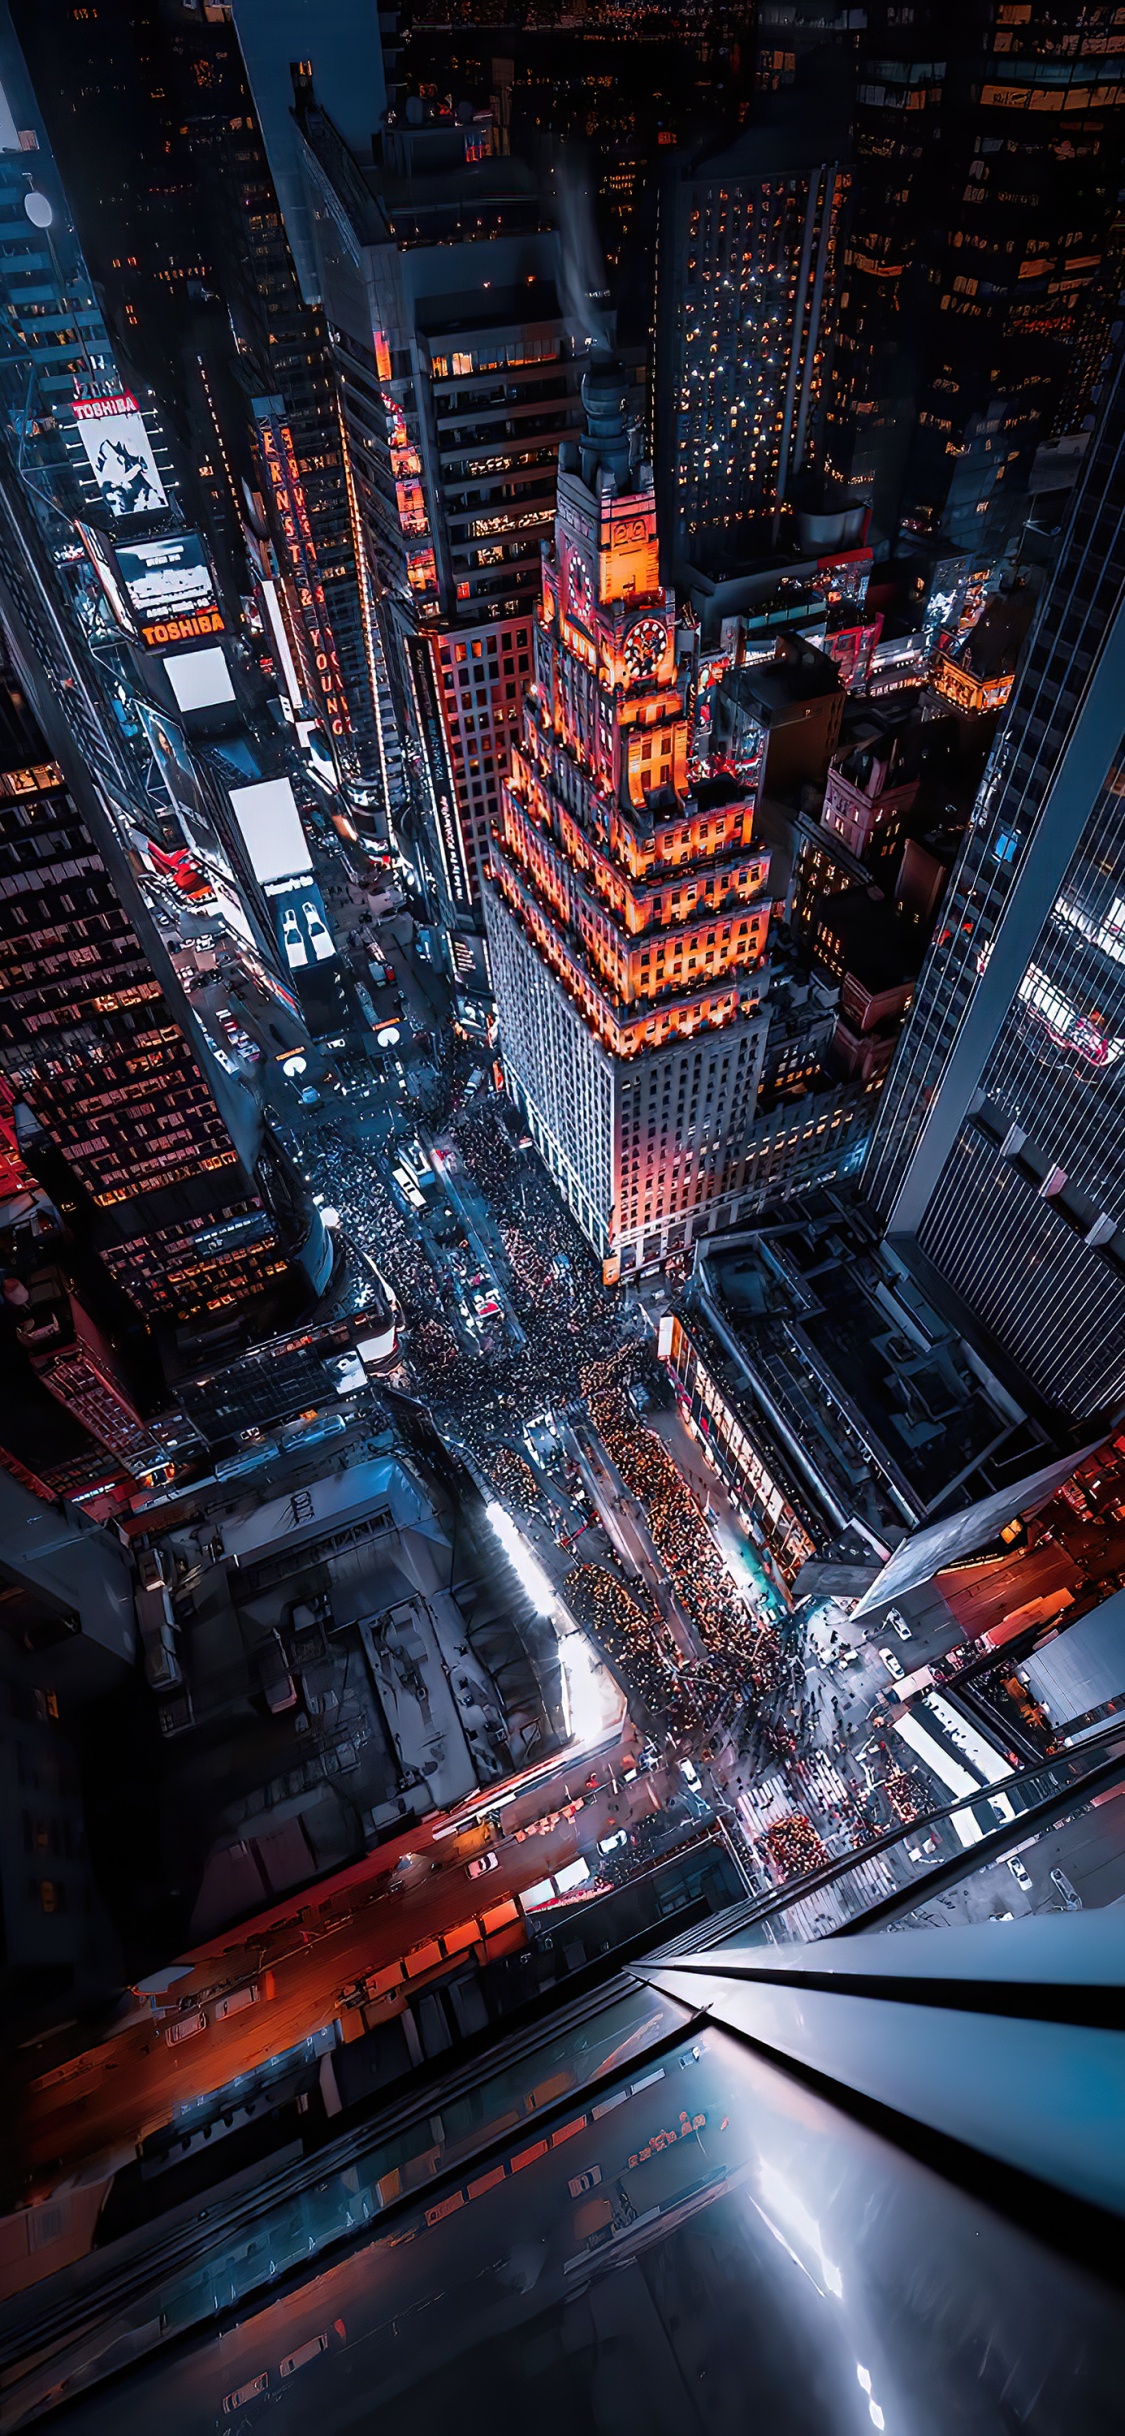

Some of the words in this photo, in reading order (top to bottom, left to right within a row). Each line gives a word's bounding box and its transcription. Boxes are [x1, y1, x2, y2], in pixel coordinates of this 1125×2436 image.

[73, 397, 137, 420] TOSHIBA
[263, 431, 301, 563] ERNST
[299, 588, 313, 606] &
[309, 628, 344, 735] YOUNG
[142, 613, 225, 645] TOSHIBA
